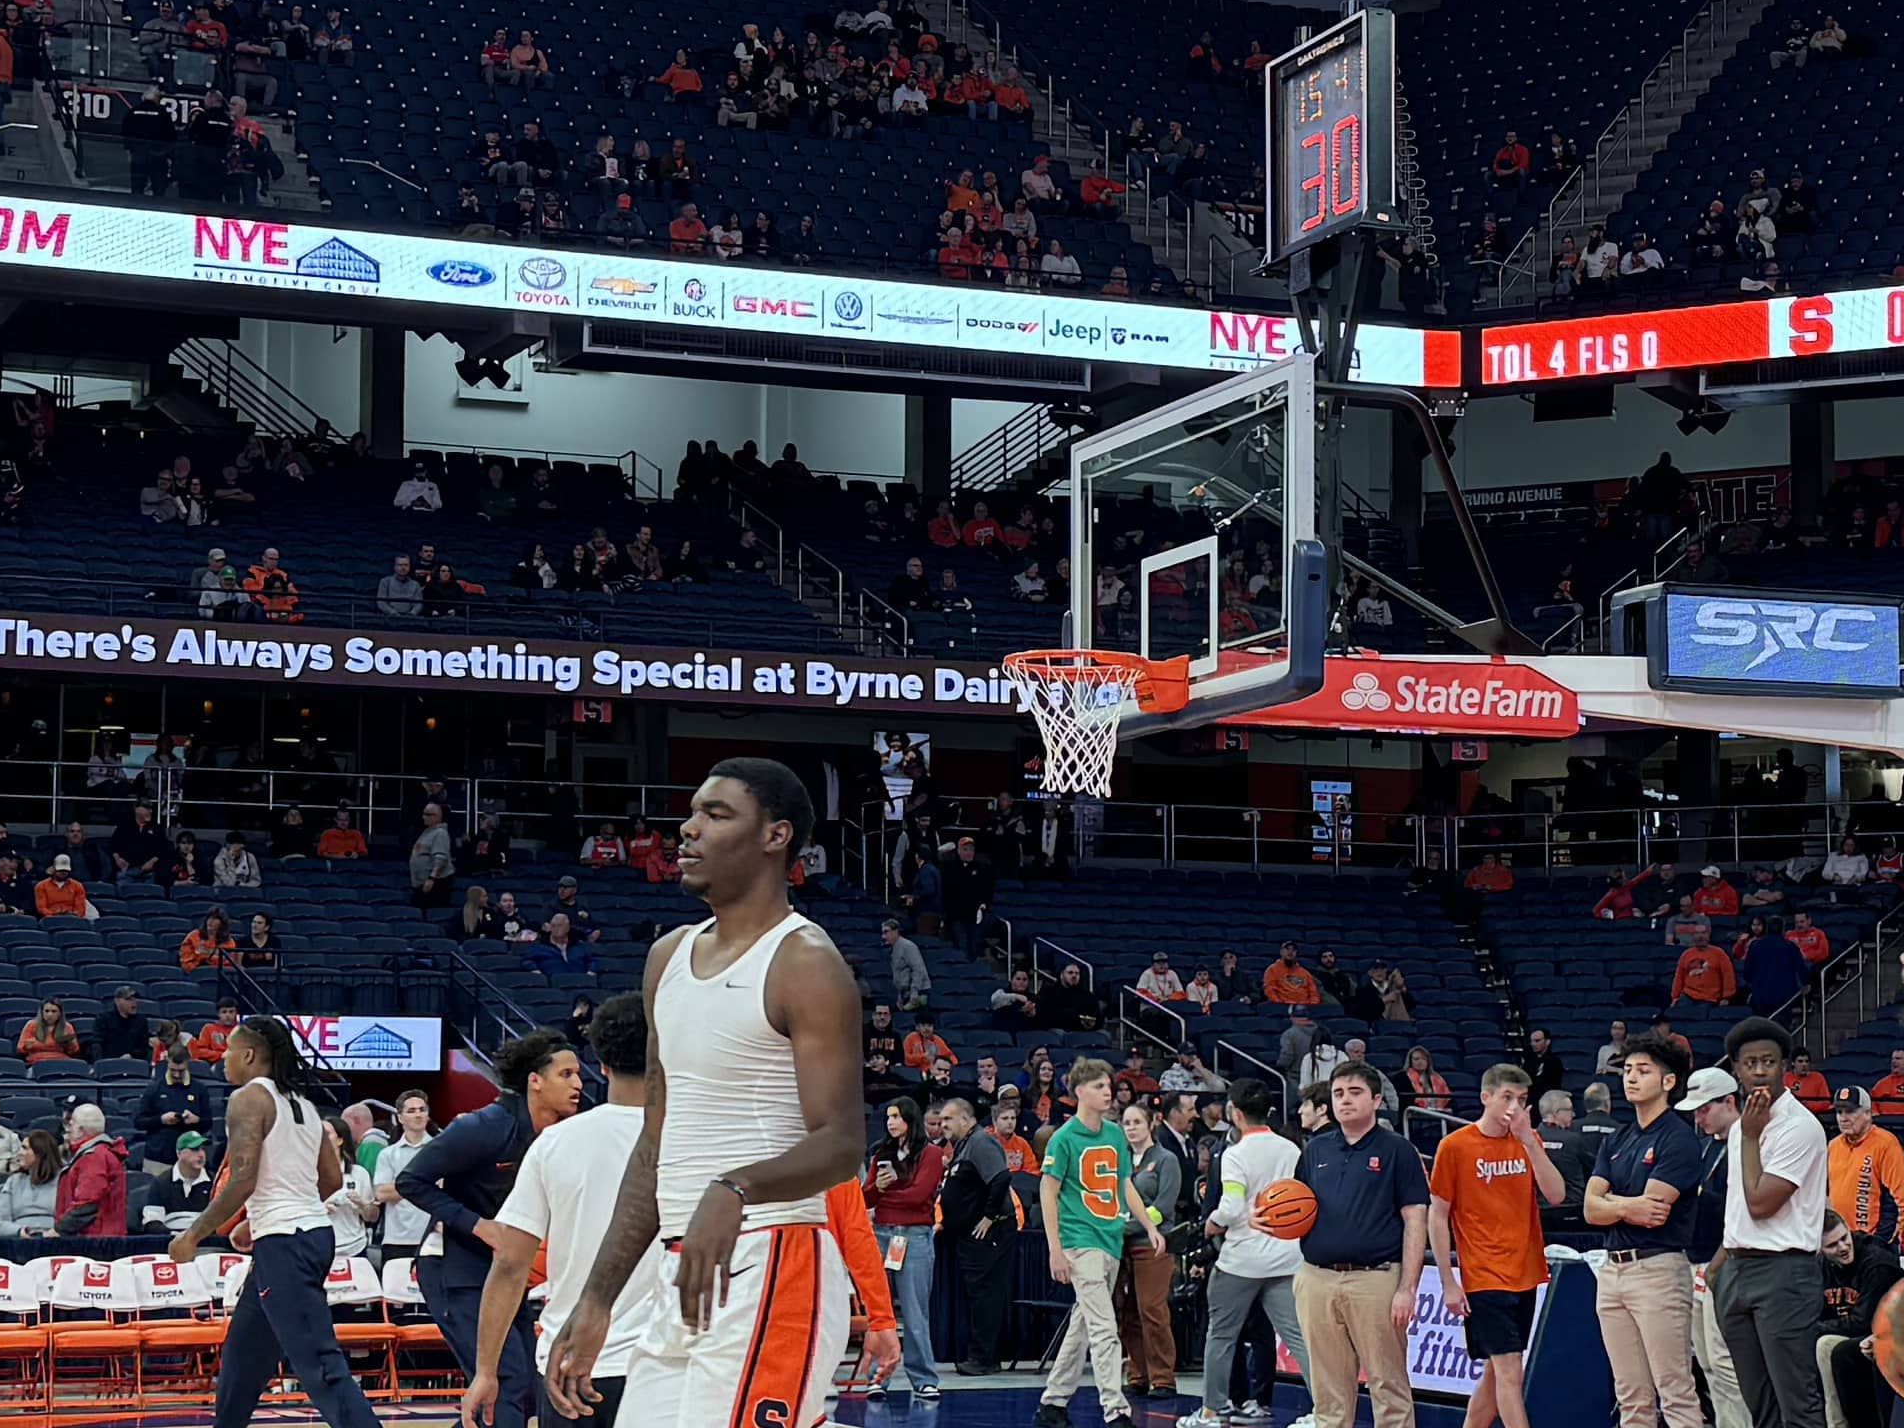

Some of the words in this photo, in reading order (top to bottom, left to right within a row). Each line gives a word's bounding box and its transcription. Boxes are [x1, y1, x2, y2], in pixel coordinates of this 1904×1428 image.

[62, 90, 110, 120] 310
[1301, 113, 1361, 232] 30
[193, 215, 290, 267] NYE
[514, 291, 571, 308] TOYOTA
[672, 302, 716, 319] BUICK
[733, 294, 818, 319] GMC
[1048, 317, 1102, 345] Jeep
[1209, 311, 1287, 356] NYE
[1788, 296, 1834, 357] S
[1488, 342, 1540, 384] TOL
[1548, 338, 1567, 372] 4
[1578, 336, 1629, 373] FLS
[1640, 329, 1659, 368] 0
[1506, 486, 1563, 504] AVENUE
[1689, 601, 1876, 672] SRC
[167, 626, 333, 679] Always
[343, 635, 581, 693] Something
[591, 651, 743, 698] Special
[752, 661, 796, 694] at
[805, 660, 924, 707] Byrne
[934, 667, 1039, 714] Dairy
[1079, 1145, 1121, 1219] S
